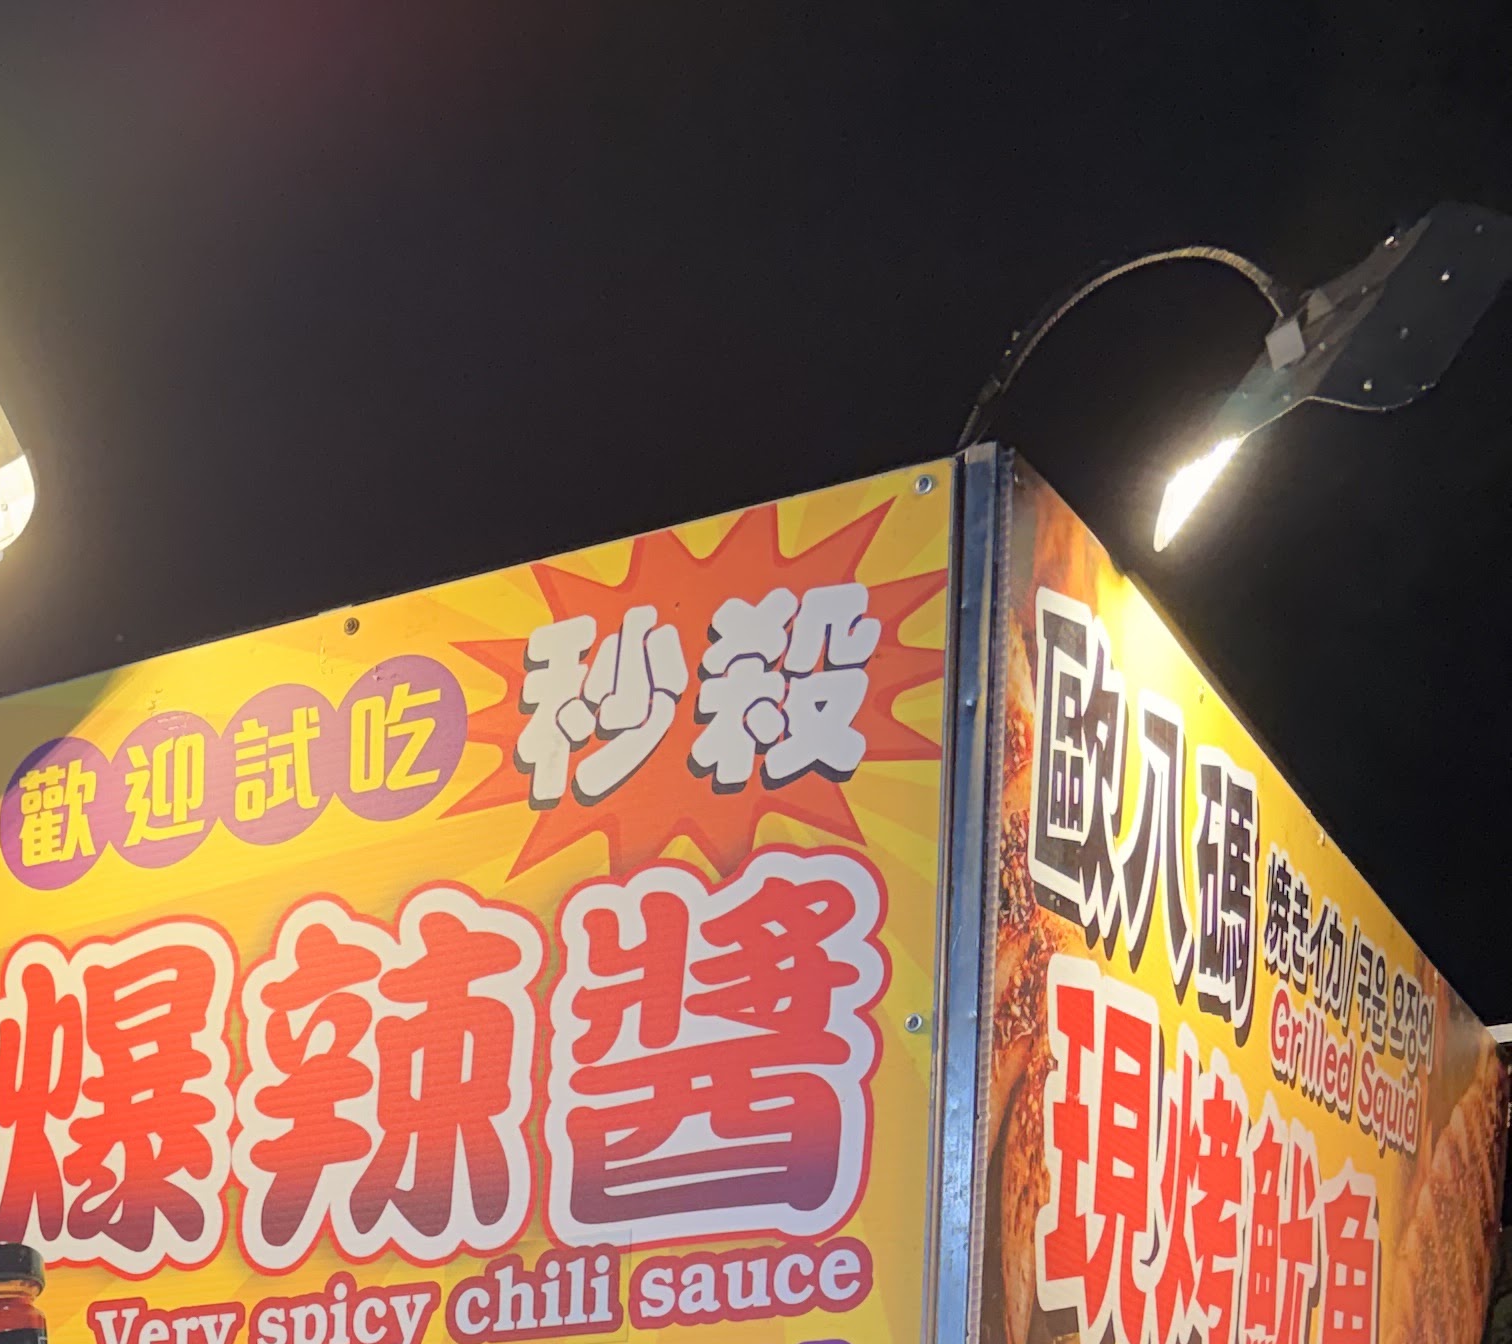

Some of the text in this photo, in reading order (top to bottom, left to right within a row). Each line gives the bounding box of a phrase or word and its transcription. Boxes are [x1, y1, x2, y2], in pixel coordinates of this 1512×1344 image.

[18, 682, 443, 868] 歡迎試吃
[514, 580, 884, 812] 秒殺
[1031, 592, 1257, 1018] 歐八碼
[1270, 986, 1421, 1150] Grilled Squid
[452, 1253, 616, 1332] chili
[638, 1245, 863, 1321] sauce
